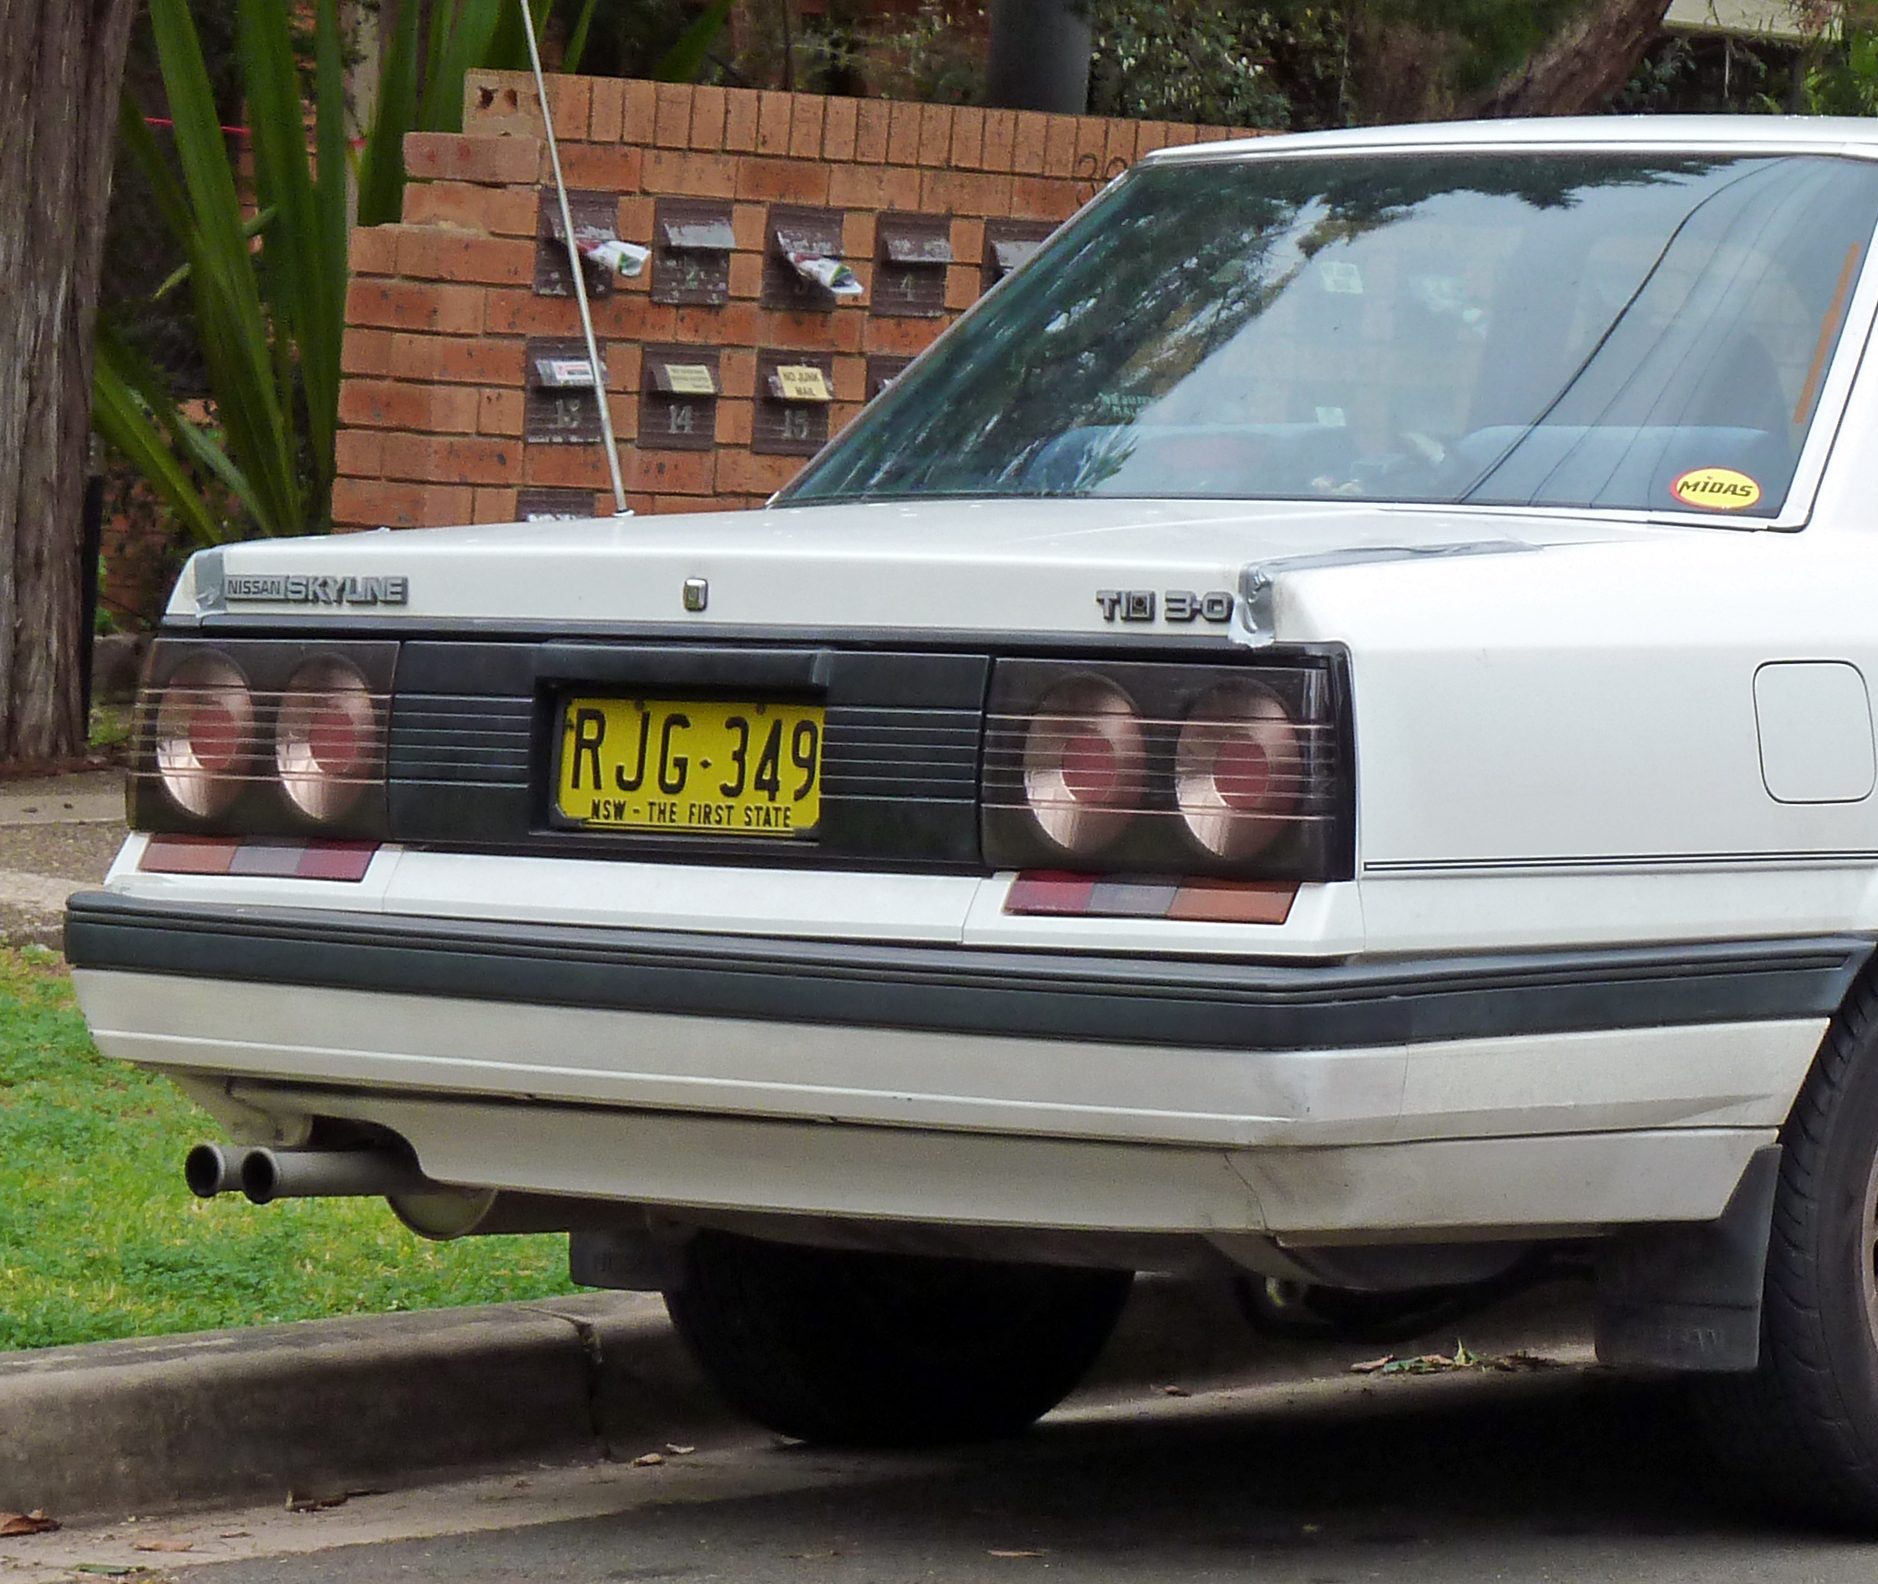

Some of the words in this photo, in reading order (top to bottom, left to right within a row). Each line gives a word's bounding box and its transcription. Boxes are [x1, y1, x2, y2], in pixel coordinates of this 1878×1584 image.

[669, 404, 694, 434] 14
[783, 408, 808, 439] 15
[227, 580, 281, 595] NISSAN
[286, 576, 409, 605] SKYLINE
[591, 799, 626, 821] NSW
[648, 802, 677, 824] THE
[688, 803, 734, 825] FIRST
[744, 805, 792, 828] STATE
